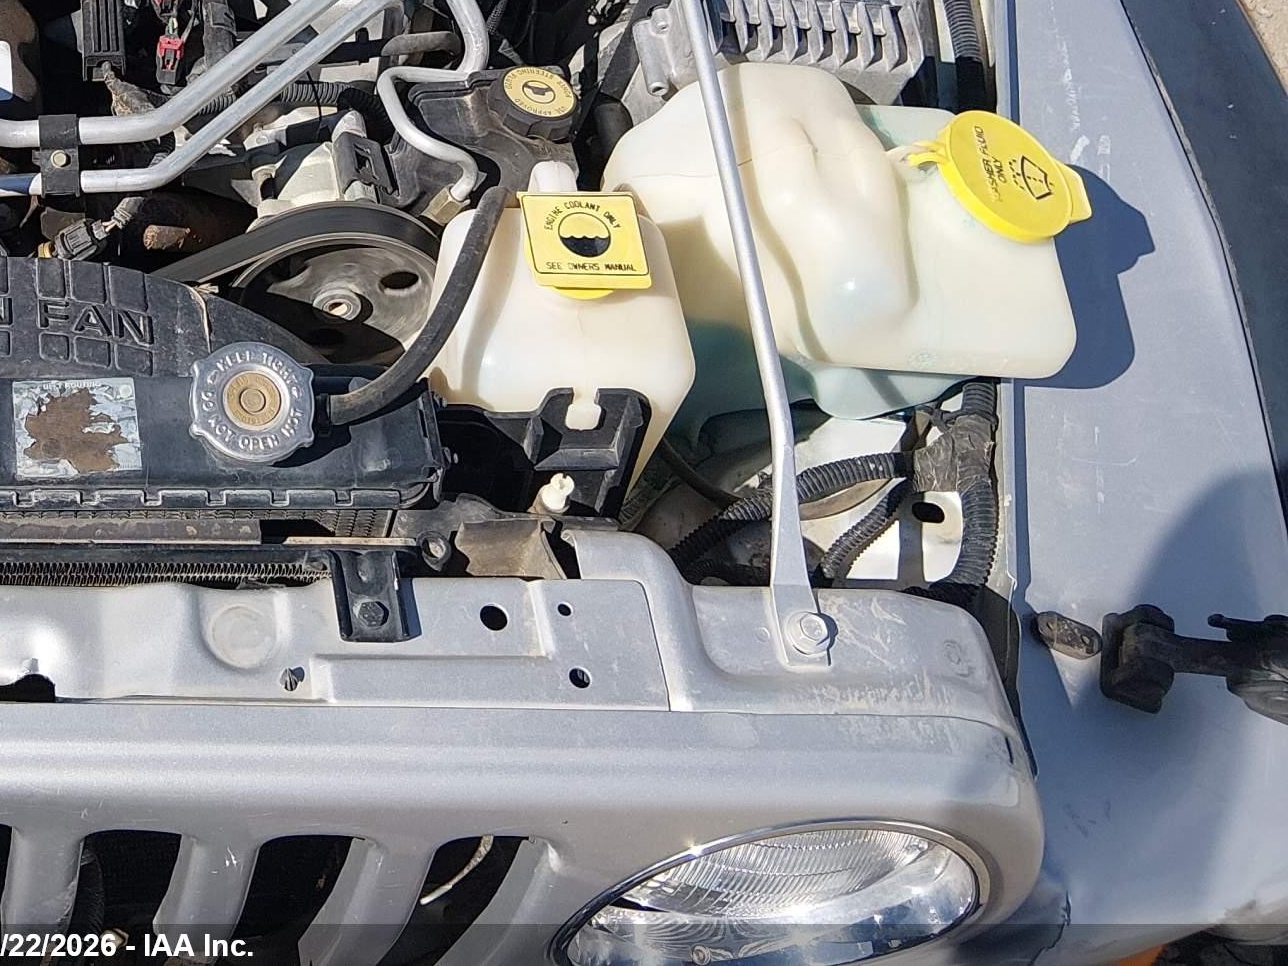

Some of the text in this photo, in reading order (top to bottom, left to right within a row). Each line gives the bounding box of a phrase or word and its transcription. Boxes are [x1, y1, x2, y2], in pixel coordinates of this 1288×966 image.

[517, 68, 554, 80] STEERING
[974, 125, 990, 155] FLUID
[992, 155, 1007, 184] ONLY
[544, 200, 622, 231] ENGINE COOLANT ONLY
[545, 261, 637, 272] SEE OWNERS MANUAL
[37, 297, 154, 347] FAN
[208, 414, 236, 442] NOT
[239, 434, 280, 451] OPEN
[281, 408, 304, 438] HOT
